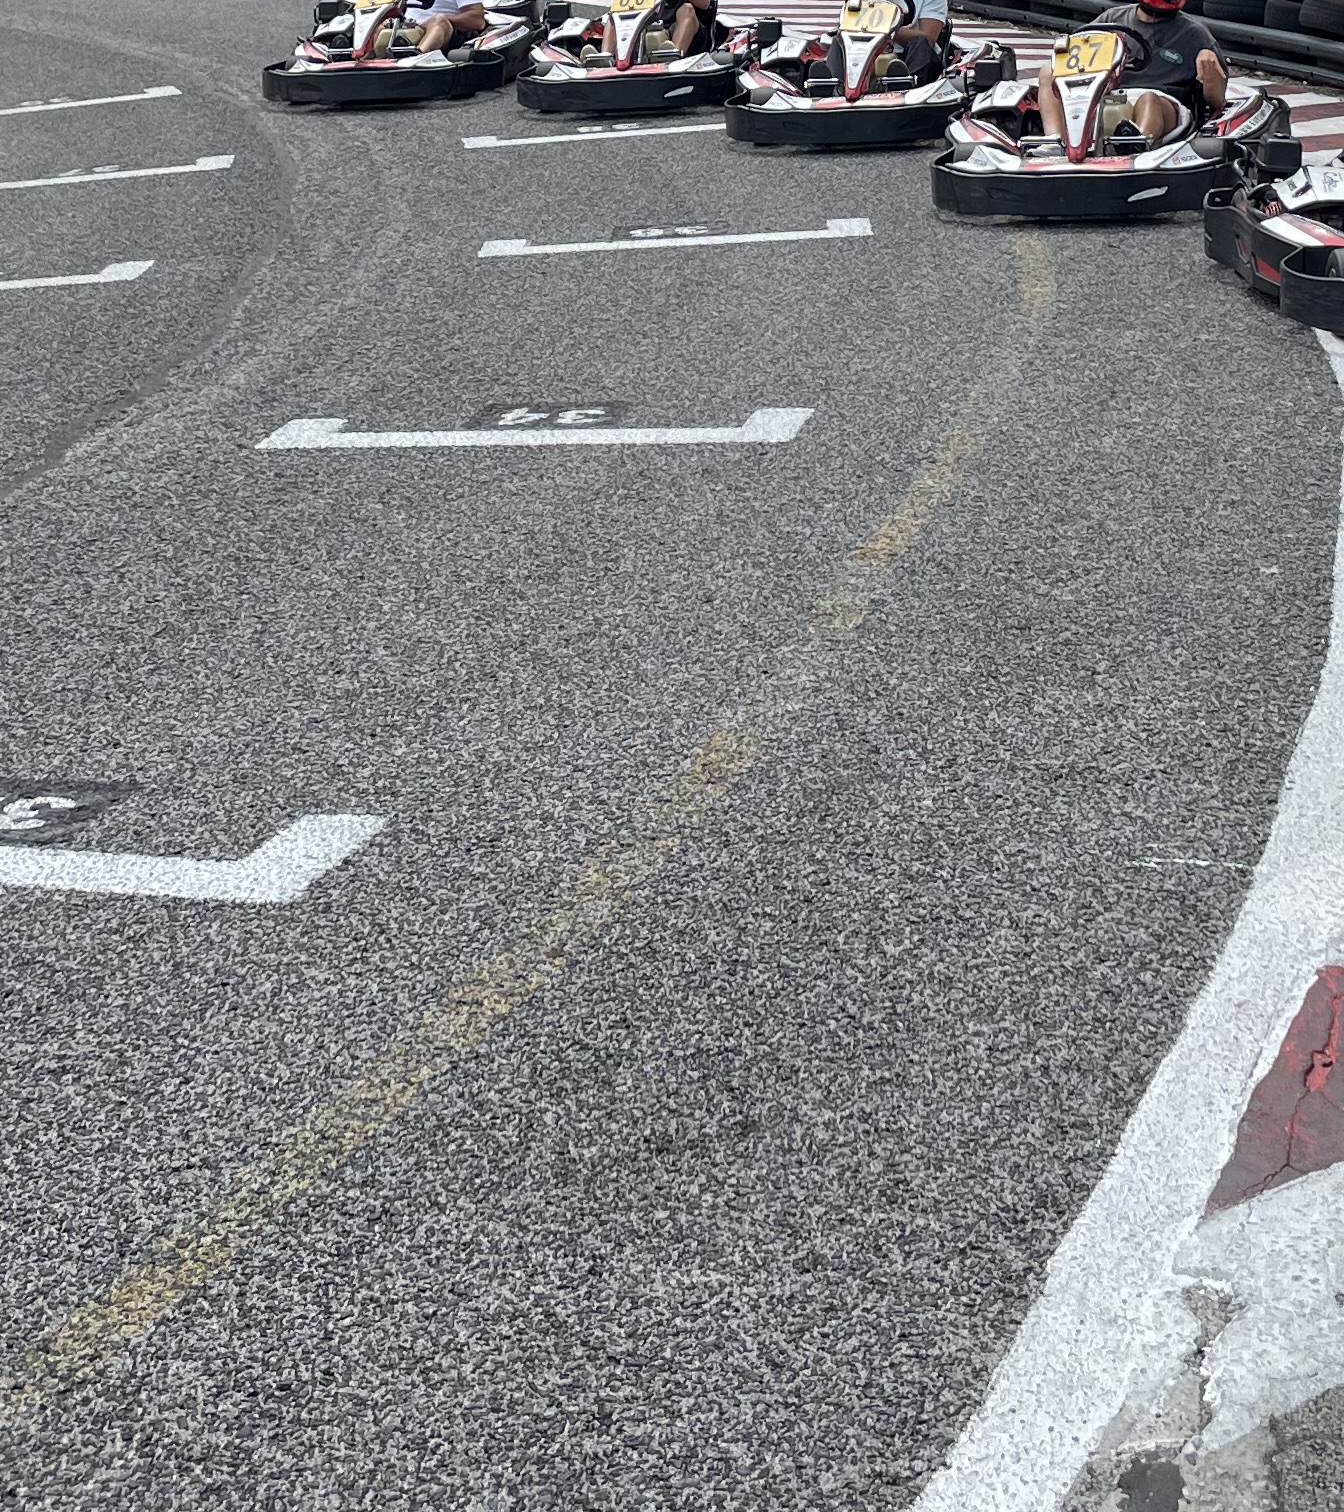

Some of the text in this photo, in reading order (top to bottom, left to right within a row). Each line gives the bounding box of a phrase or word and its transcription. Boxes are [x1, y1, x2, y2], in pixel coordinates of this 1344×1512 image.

[855, 7, 884, 28] 70
[1066, 41, 1103, 69] 87
[499, 407, 605, 426] 34
